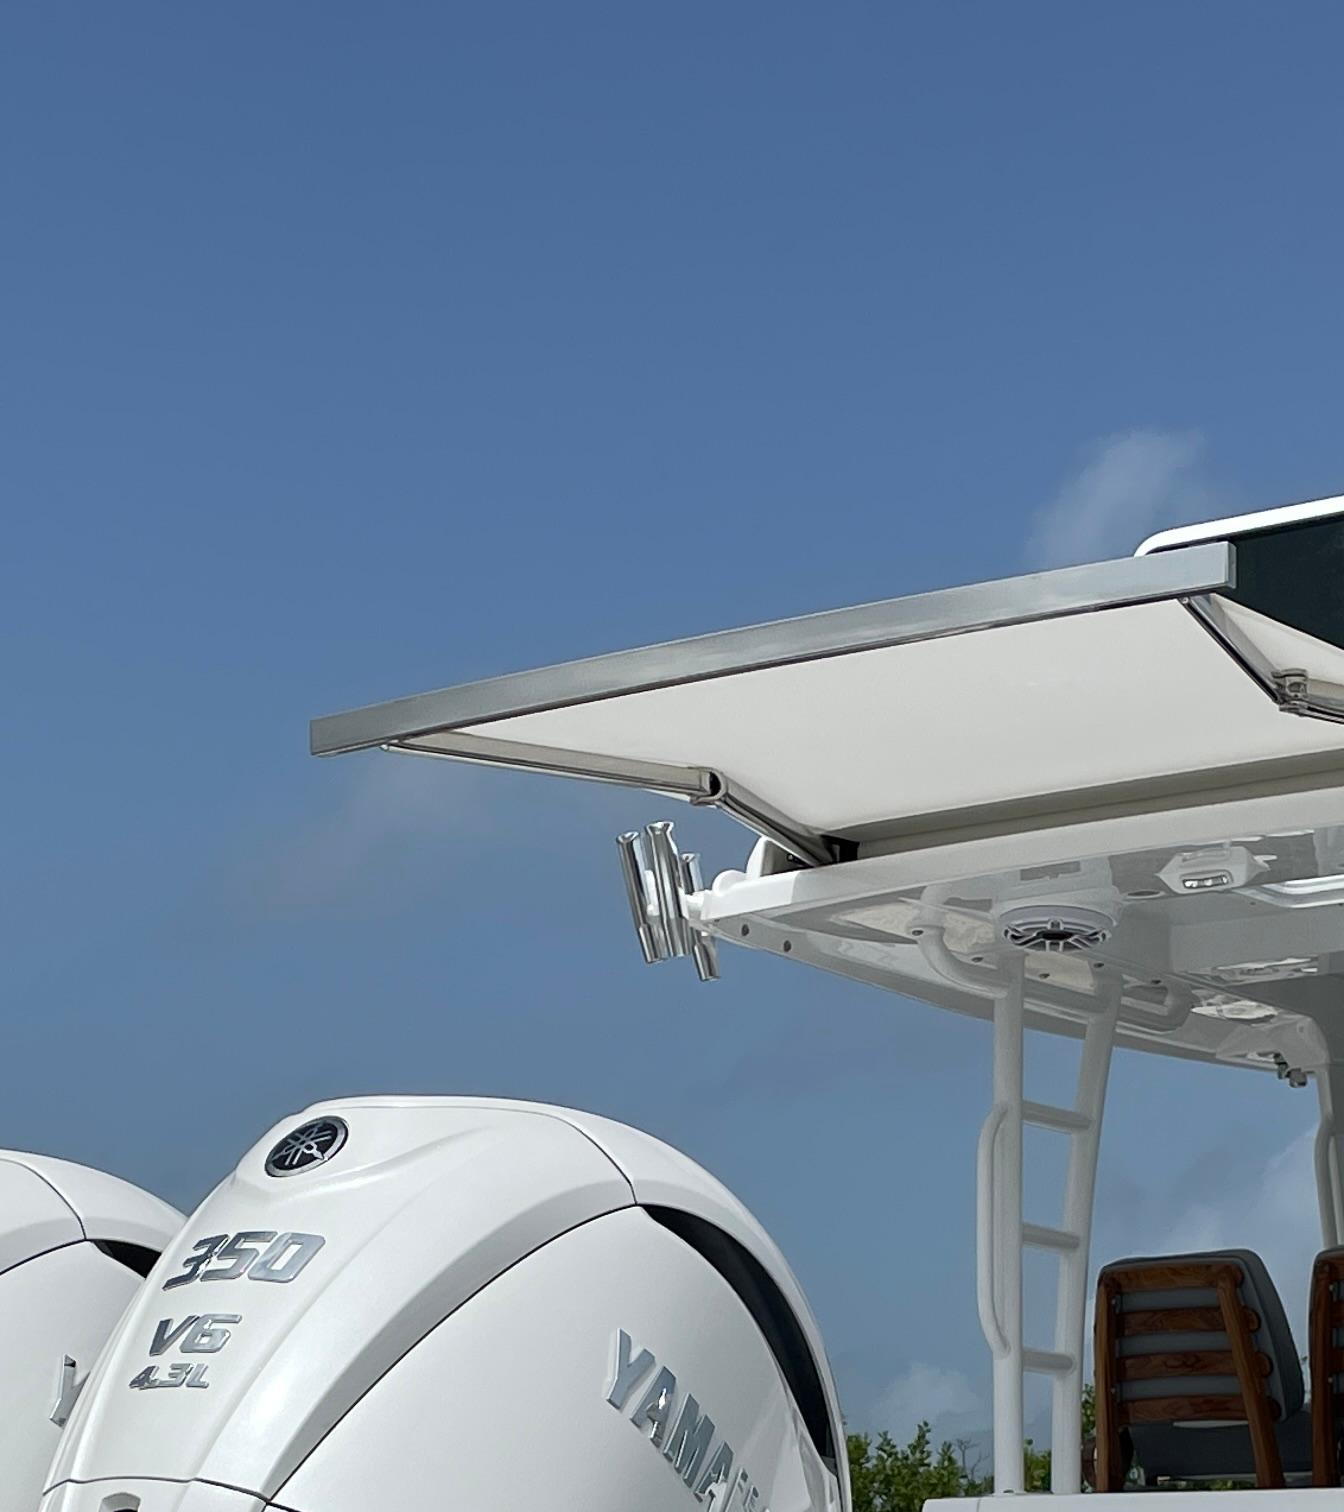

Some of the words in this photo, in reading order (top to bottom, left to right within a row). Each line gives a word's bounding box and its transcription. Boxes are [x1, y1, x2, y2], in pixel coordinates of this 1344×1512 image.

[162, 1230, 327, 1291] 350
[149, 1313, 243, 1357] V6
[128, 1363, 210, 1391] 4.3L
